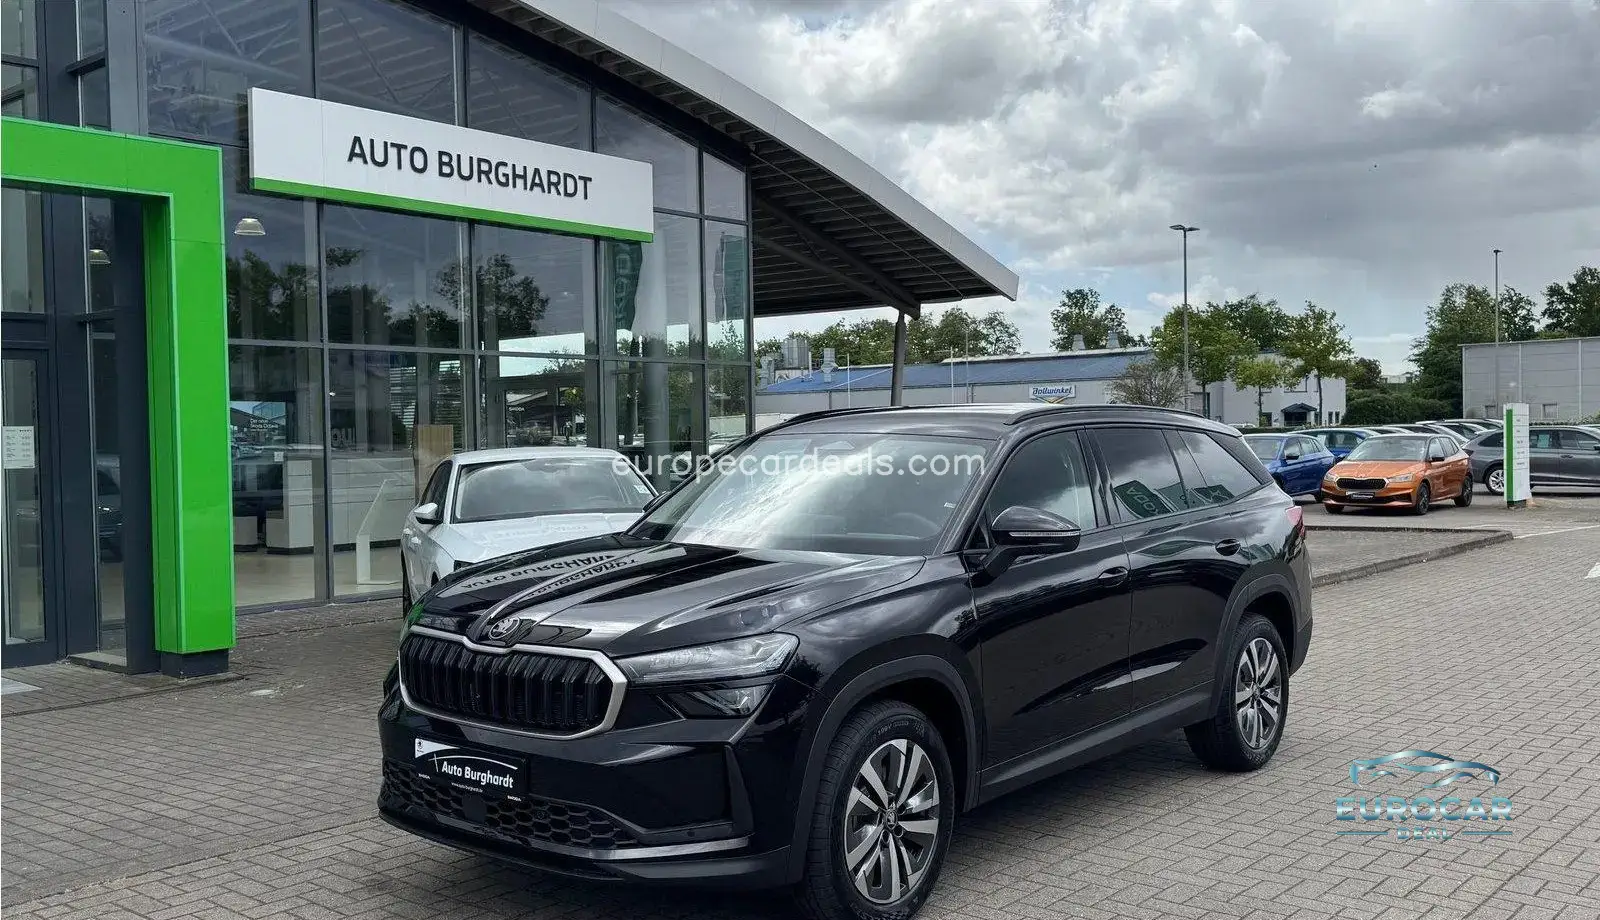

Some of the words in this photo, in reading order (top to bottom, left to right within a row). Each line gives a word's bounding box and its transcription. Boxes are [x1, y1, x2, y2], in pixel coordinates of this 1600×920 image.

[347, 135, 429, 174] AUTO
[437, 150, 593, 200] BURGHARDT
[441, 760, 463, 777] Auto
[464, 766, 514, 788] Burghardt
